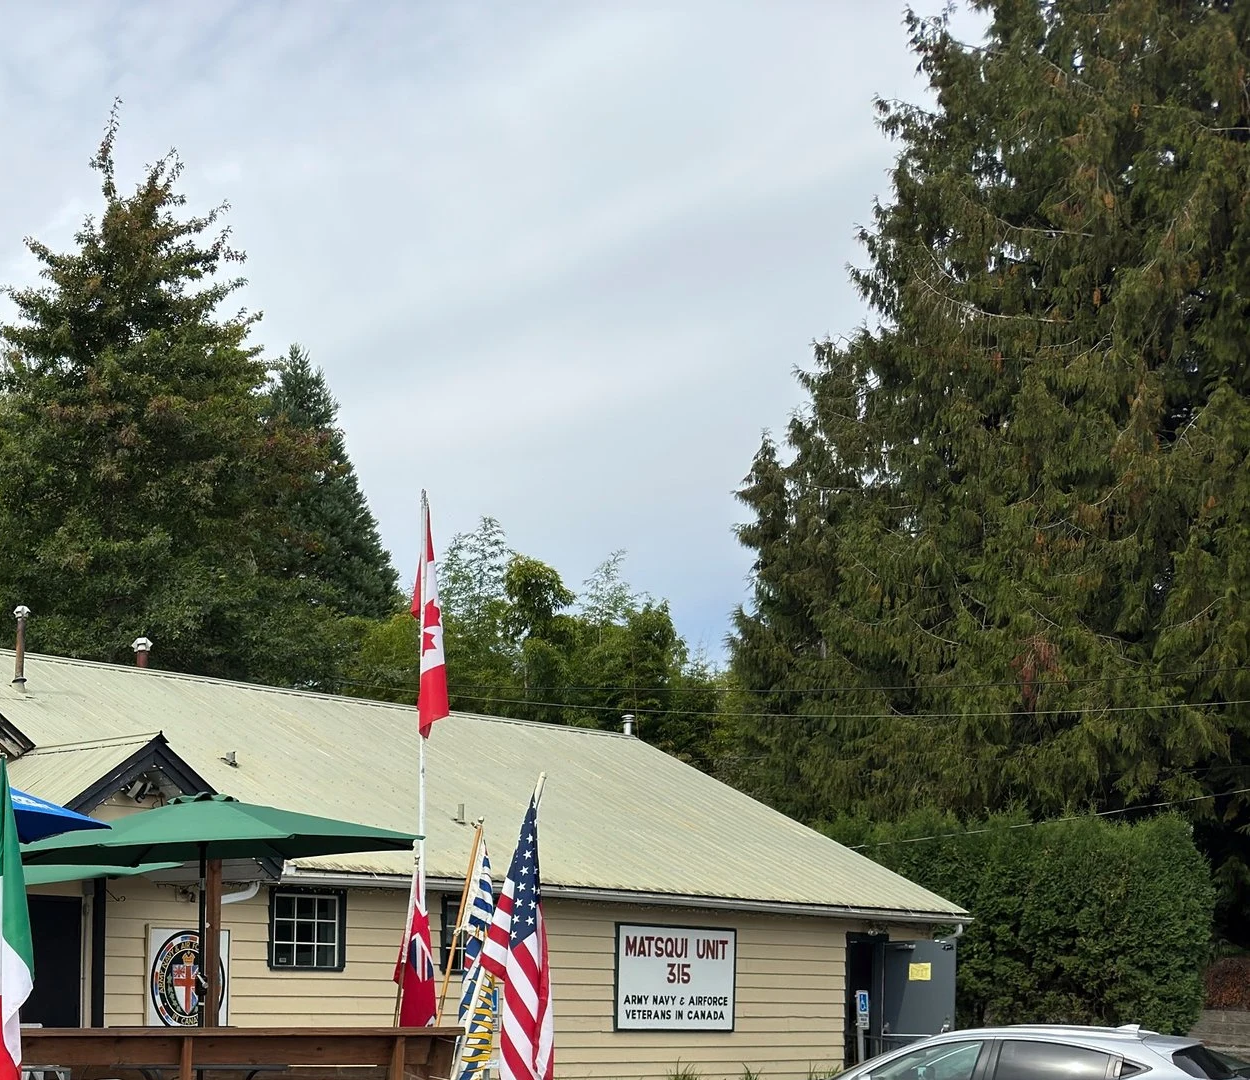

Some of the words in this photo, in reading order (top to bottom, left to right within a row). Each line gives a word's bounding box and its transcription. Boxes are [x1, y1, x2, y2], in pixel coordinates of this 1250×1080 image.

[162, 949, 175, 969] NAVY
[180, 941, 191, 950] AIR
[625, 935, 688, 958] MATSQUI
[696, 938, 728, 960] UNIT
[666, 963, 691, 984] 315
[623, 994, 649, 1005] ARMY
[652, 996, 676, 1005] NAVY
[688, 996, 728, 1006] AIRFORCE
[180, 1016, 198, 1026] CANA
[625, 1009, 672, 1020] VETERANS
[675, 1010, 684, 1020] IN
[687, 1011, 725, 1020] CANADA
